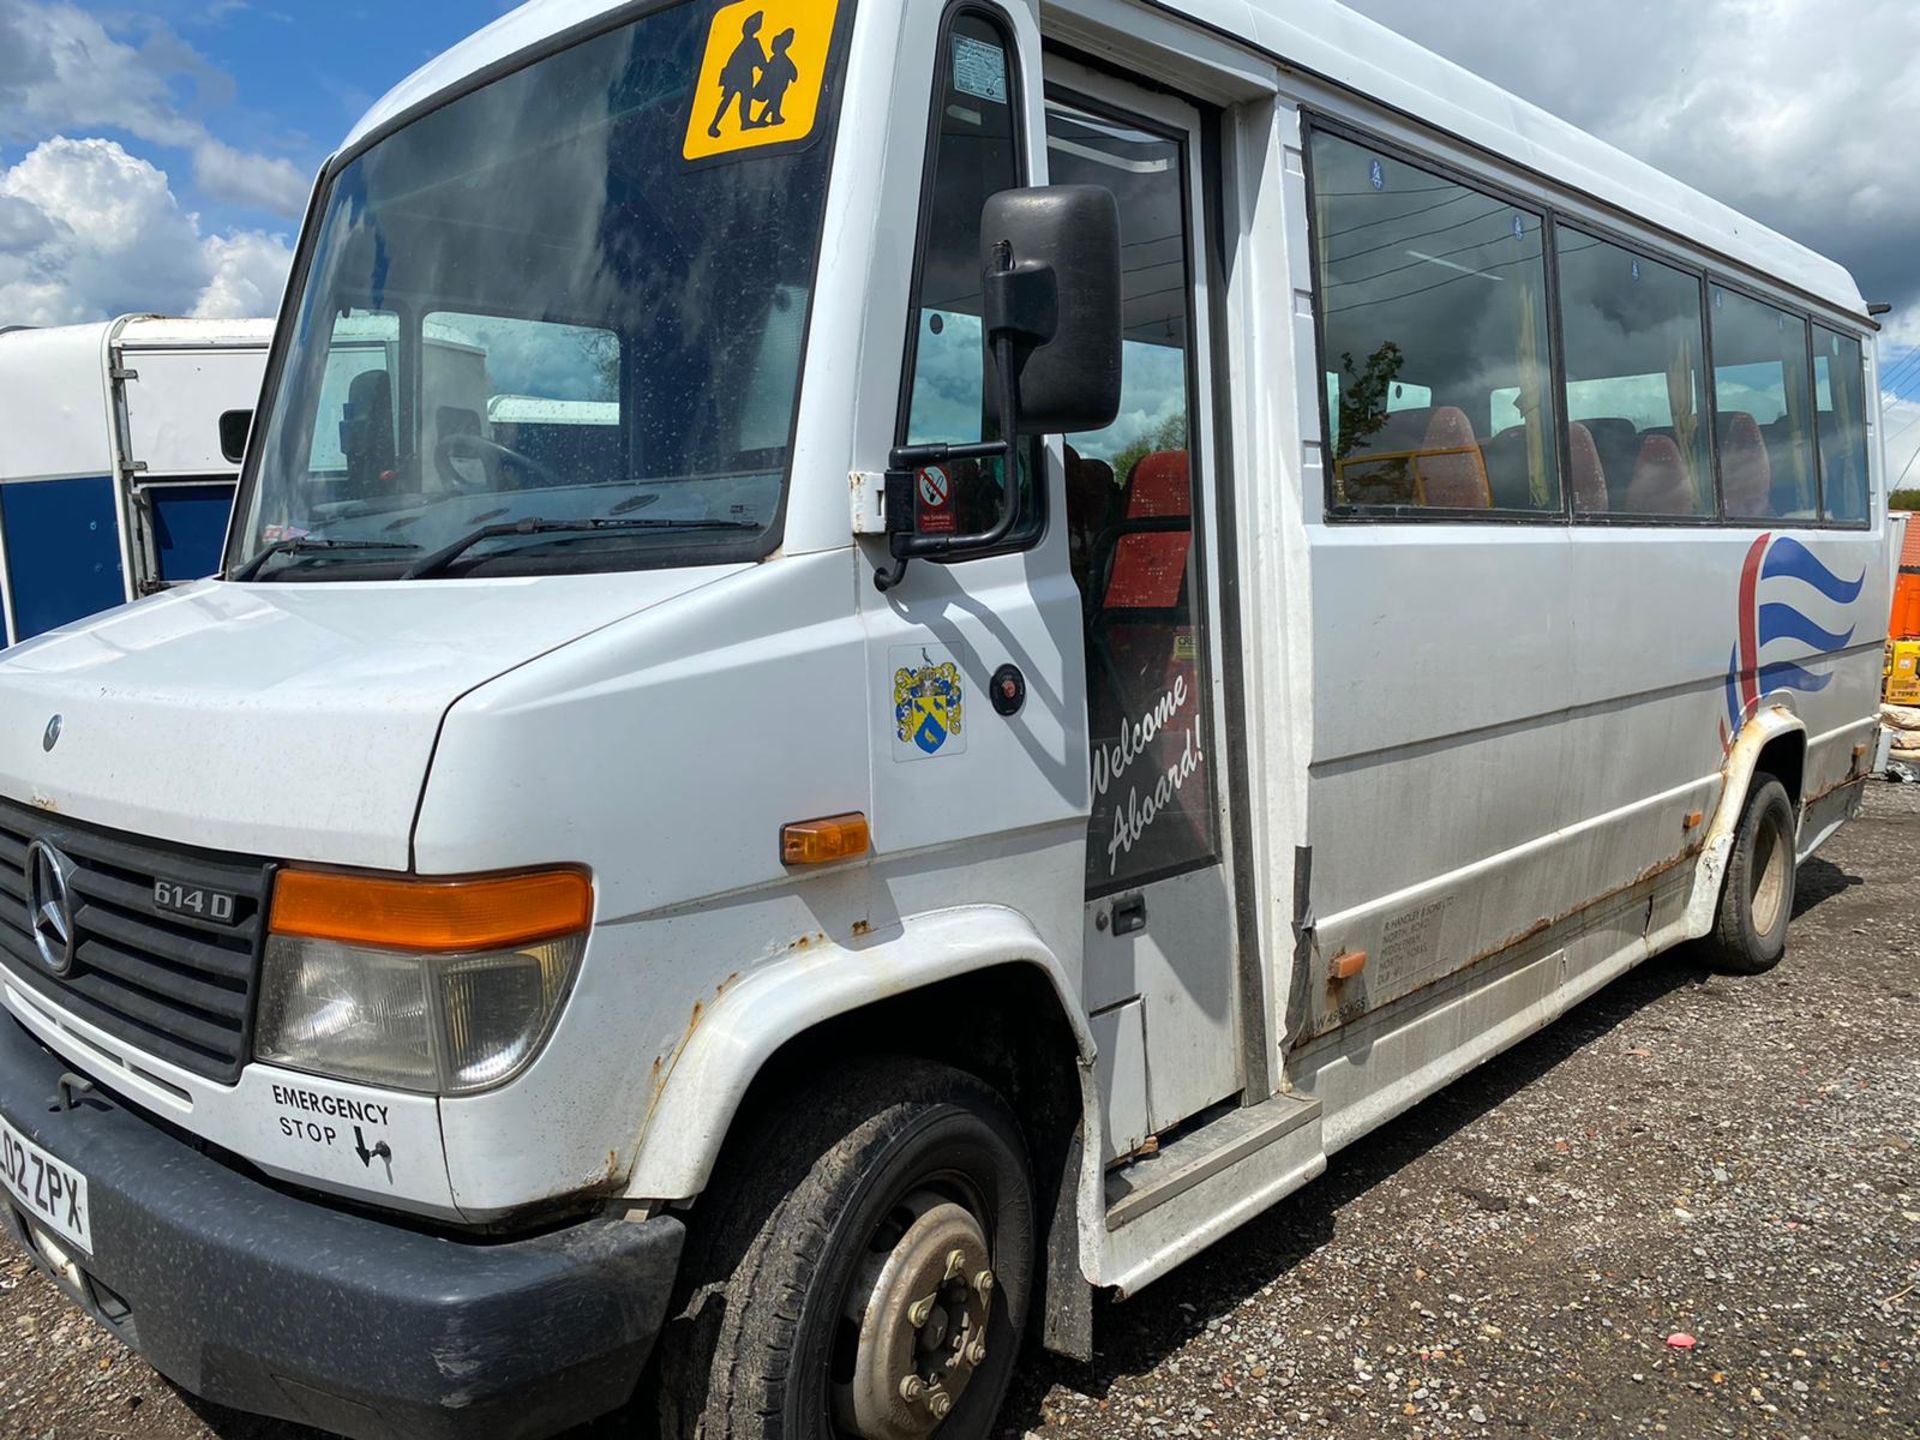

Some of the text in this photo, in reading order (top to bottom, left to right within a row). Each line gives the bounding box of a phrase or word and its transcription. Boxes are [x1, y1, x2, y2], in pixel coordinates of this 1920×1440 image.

[1108, 713, 1204, 876] Aboard!
[154, 881, 233, 919] 614 D
[272, 1085, 388, 1125] EMERGENCY
[280, 1117, 336, 1145] STOP
[30, 1153, 82, 1234] ZPX
